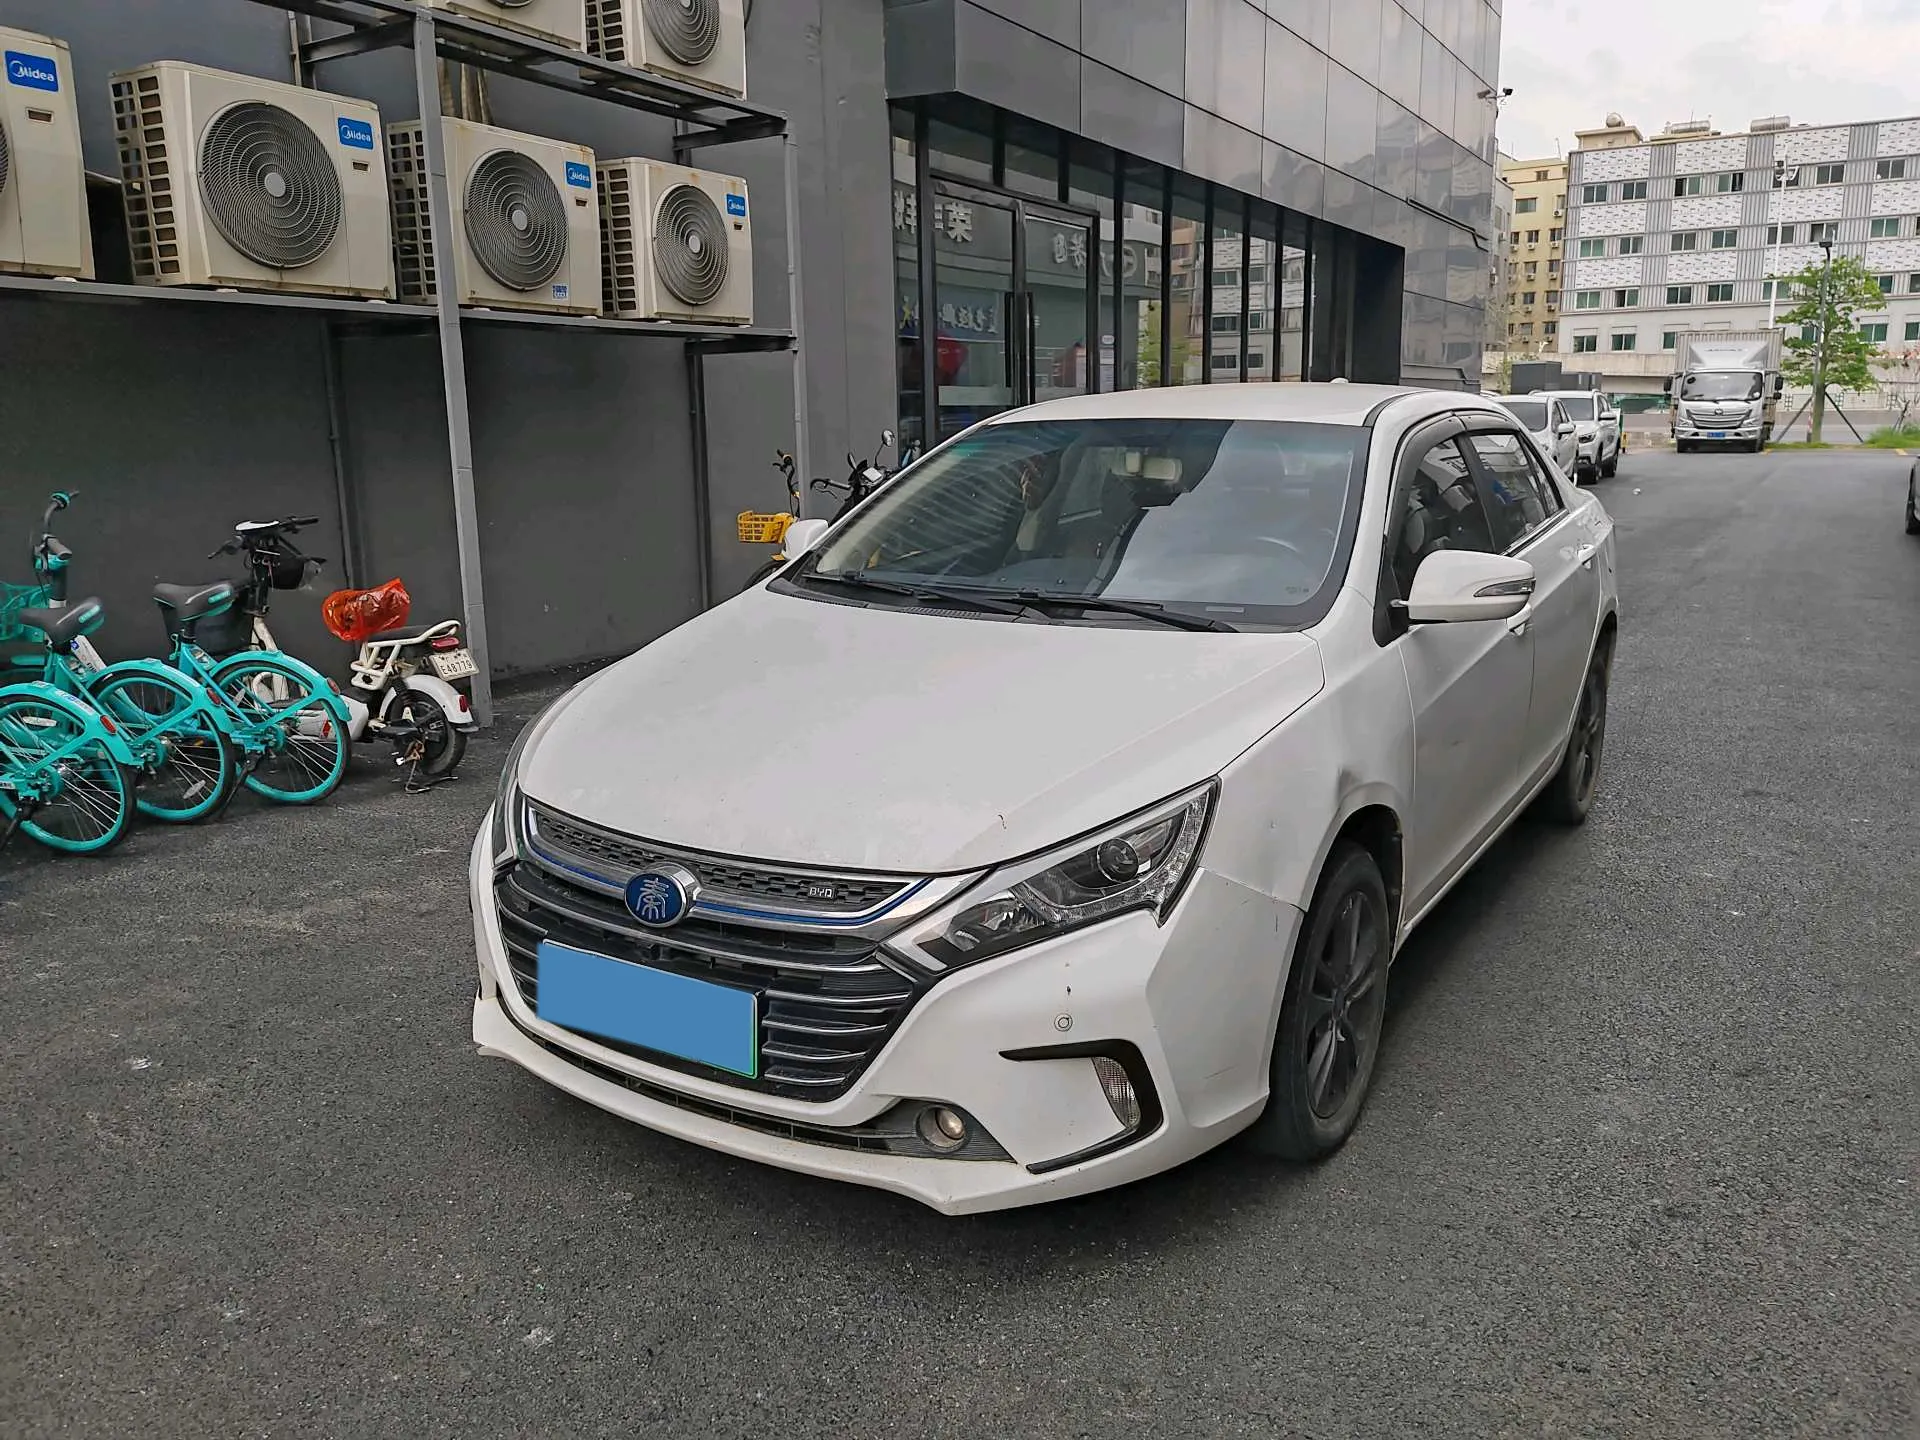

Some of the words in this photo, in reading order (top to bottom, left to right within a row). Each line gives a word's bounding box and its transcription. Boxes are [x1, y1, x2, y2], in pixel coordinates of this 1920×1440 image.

[10, 60, 55, 82] Midea
[340, 124, 371, 142] Midea
[567, 167, 590, 182] Midea
[810, 886, 833, 898] BYD
